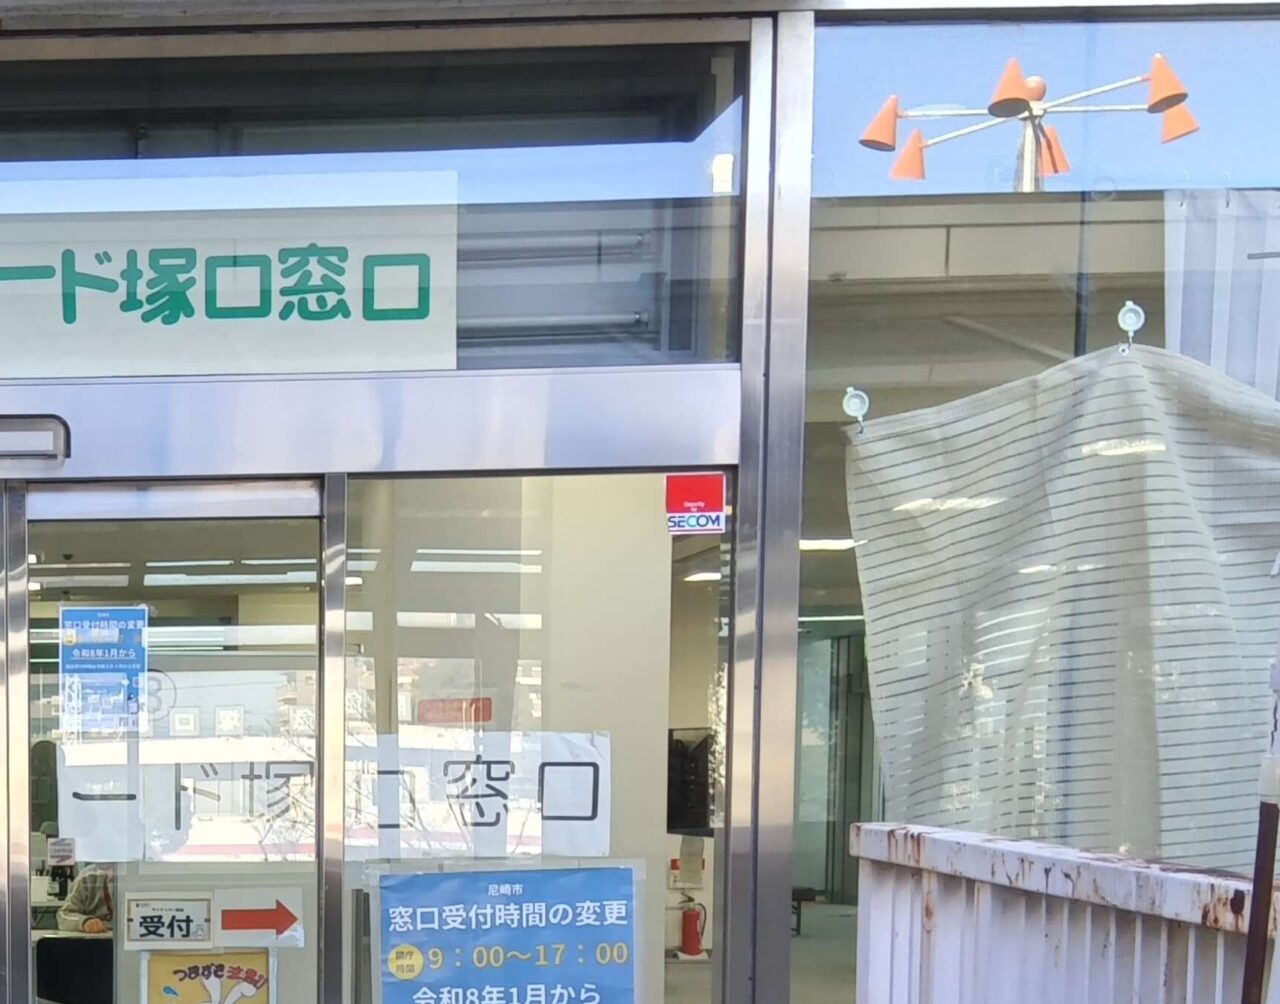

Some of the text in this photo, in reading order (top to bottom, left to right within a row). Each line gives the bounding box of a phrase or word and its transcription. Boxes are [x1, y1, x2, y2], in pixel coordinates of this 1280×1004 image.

[667, 514, 720, 528] SECOM
[487, 883, 523, 897] 尼崎市
[388, 900, 629, 932] 窓口受付時間の変更
[138, 915, 195, 938] 受付
